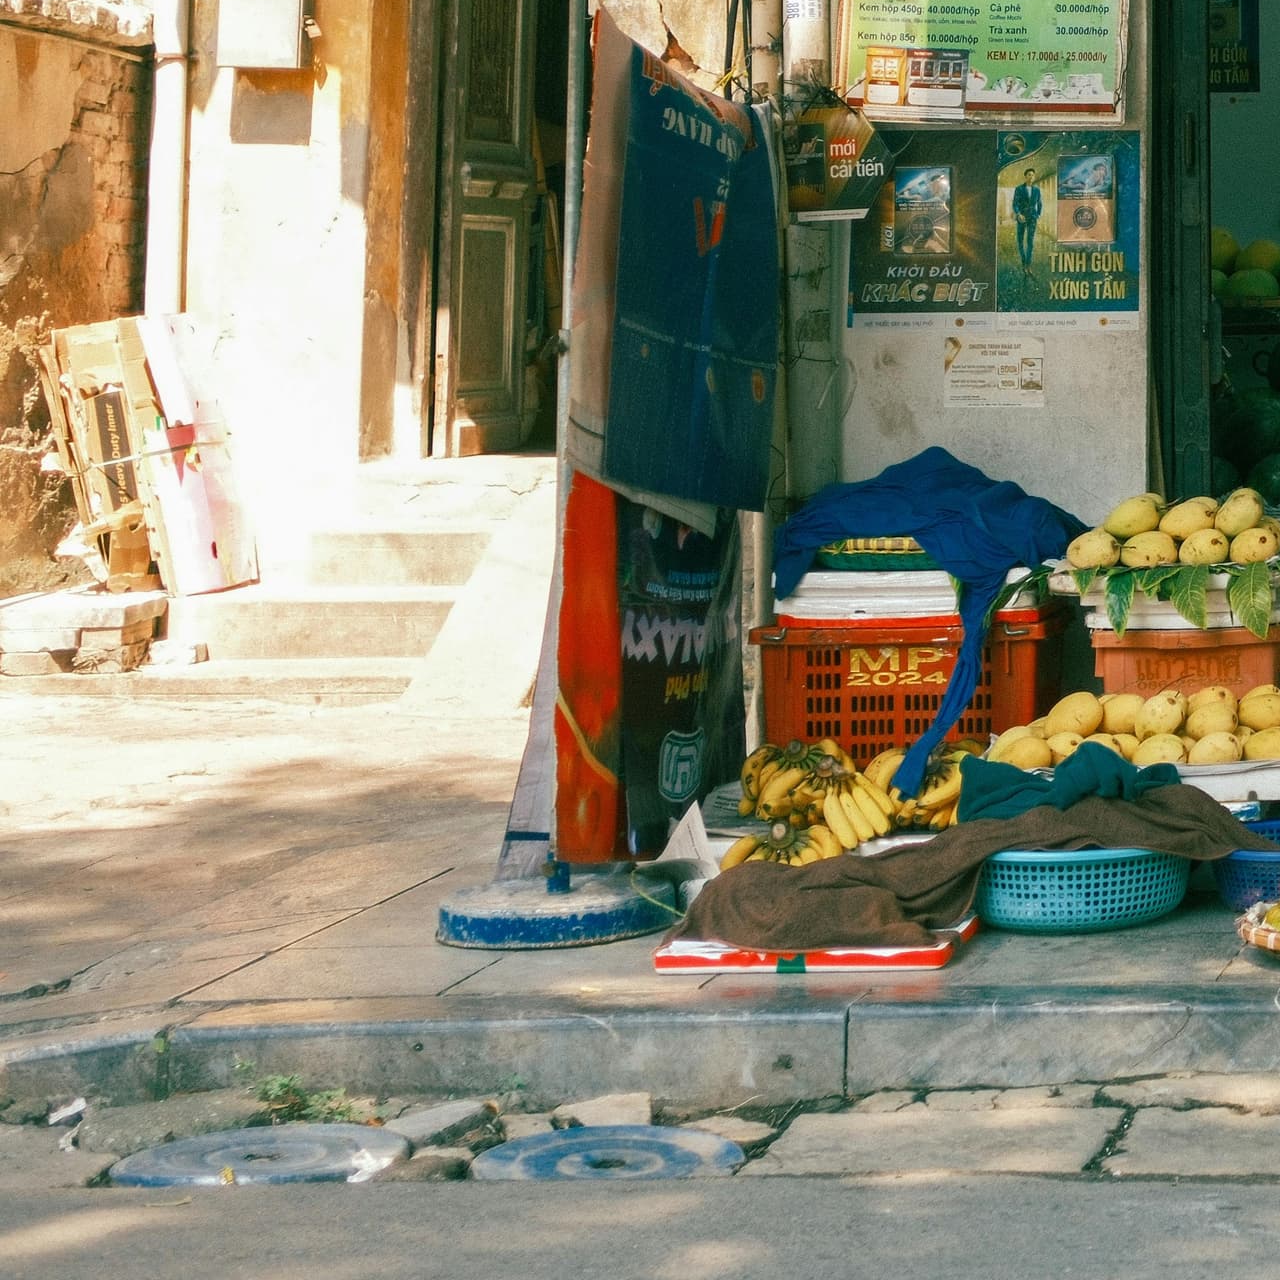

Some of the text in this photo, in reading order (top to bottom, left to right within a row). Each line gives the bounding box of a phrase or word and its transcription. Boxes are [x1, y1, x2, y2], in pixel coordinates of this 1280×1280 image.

[859, 3, 879, 11] Kem
[928, 6, 980, 16] 40.000đ/hộp
[1004, 4, 1021, 14] phê
[858, 32, 877, 40] Kem
[899, 32, 916, 42] 85g
[989, 26, 1027, 34] Trà xanh
[1056, 27, 1109, 37] 30.000đ/hộp
[927, 34, 979, 44] 10.000đ/hộp
[987, 51, 1007, 60] KEM
[1009, 51, 1019, 60] LY
[830, 139, 856, 157] mới
[830, 157, 884, 178] cải tiến
[1050, 252, 1124, 275] TINH GỌN
[861, 278, 988, 306] KHÁC BIỆT
[1050, 278, 1088, 300] XỨNG
[105, 403, 116, 432] Inner
[109, 432, 121, 459] Duty
[850, 648, 944, 672] MP
[847, 672, 948, 686] 2024
